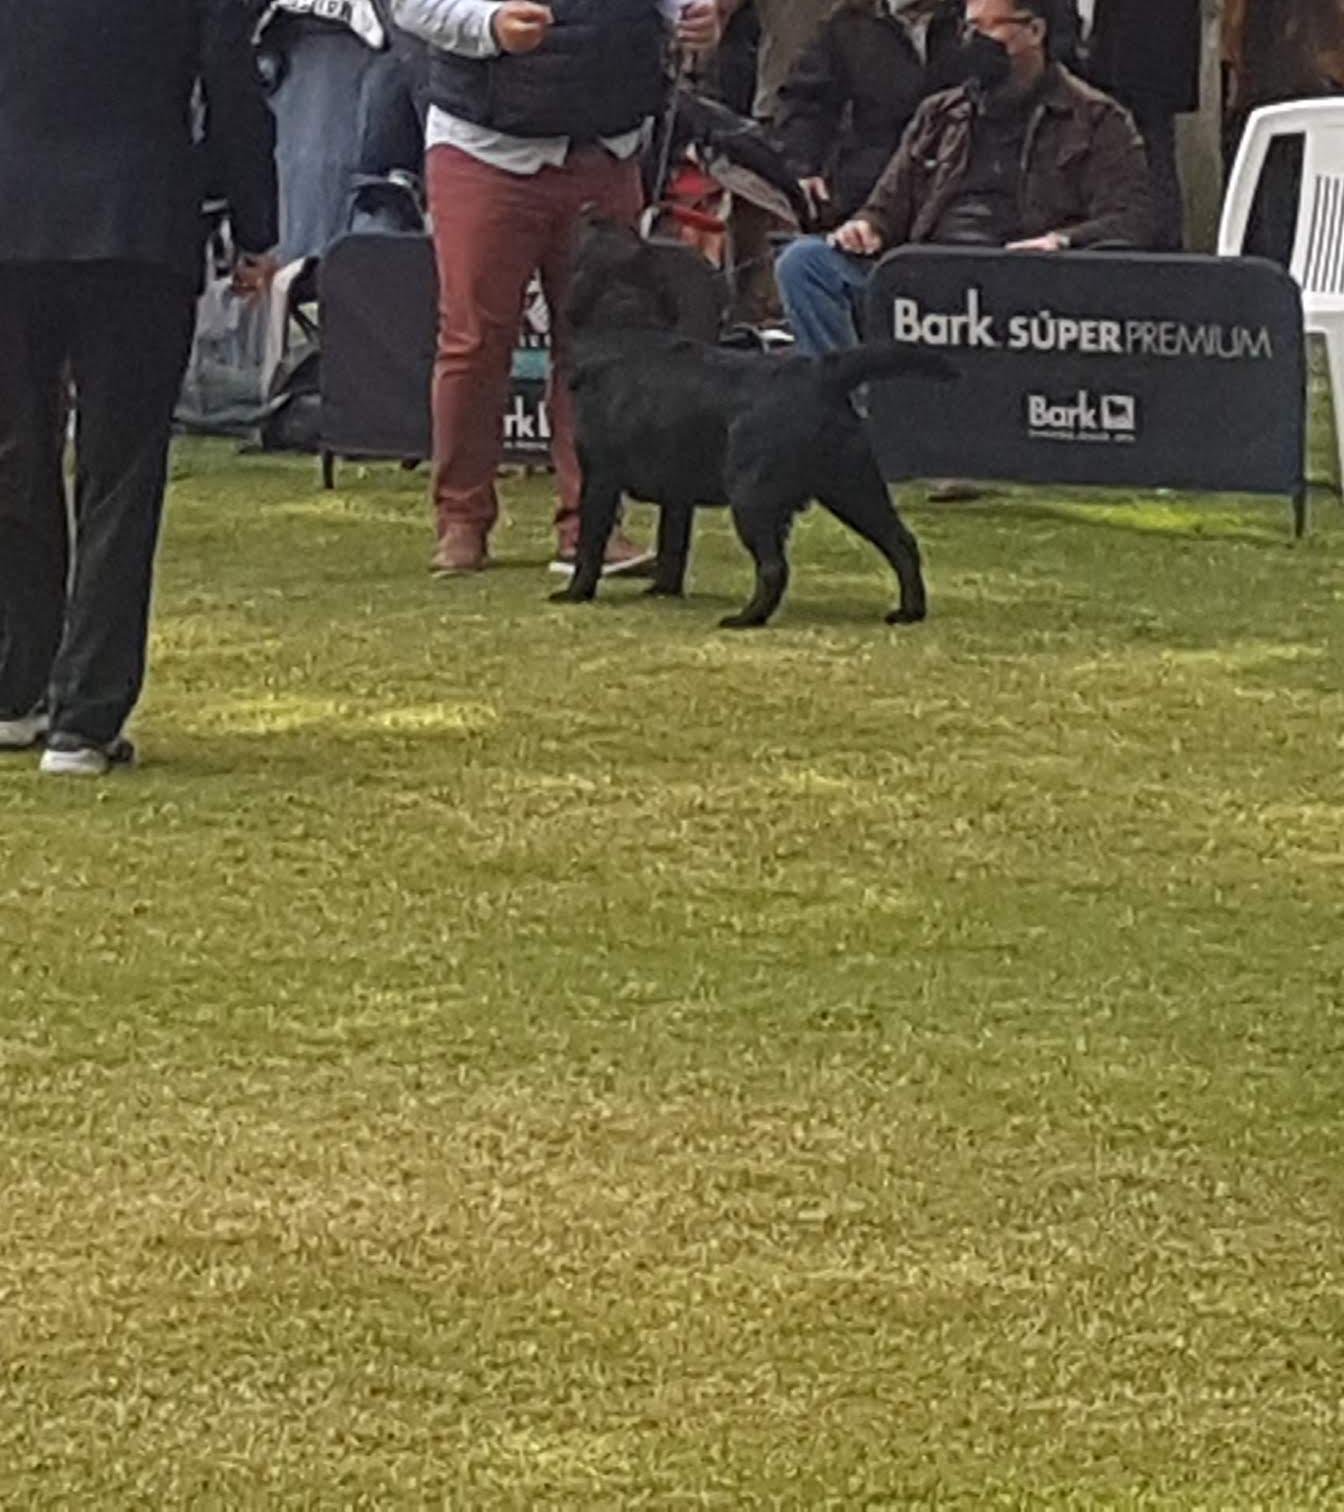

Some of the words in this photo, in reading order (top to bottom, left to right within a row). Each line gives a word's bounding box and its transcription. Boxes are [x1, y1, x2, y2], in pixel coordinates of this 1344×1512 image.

[894, 288, 998, 347] Bark
[1009, 310, 1123, 353] SÚPER
[1125, 320, 1272, 359] PREMIUM
[1028, 389, 1097, 429] Bark
